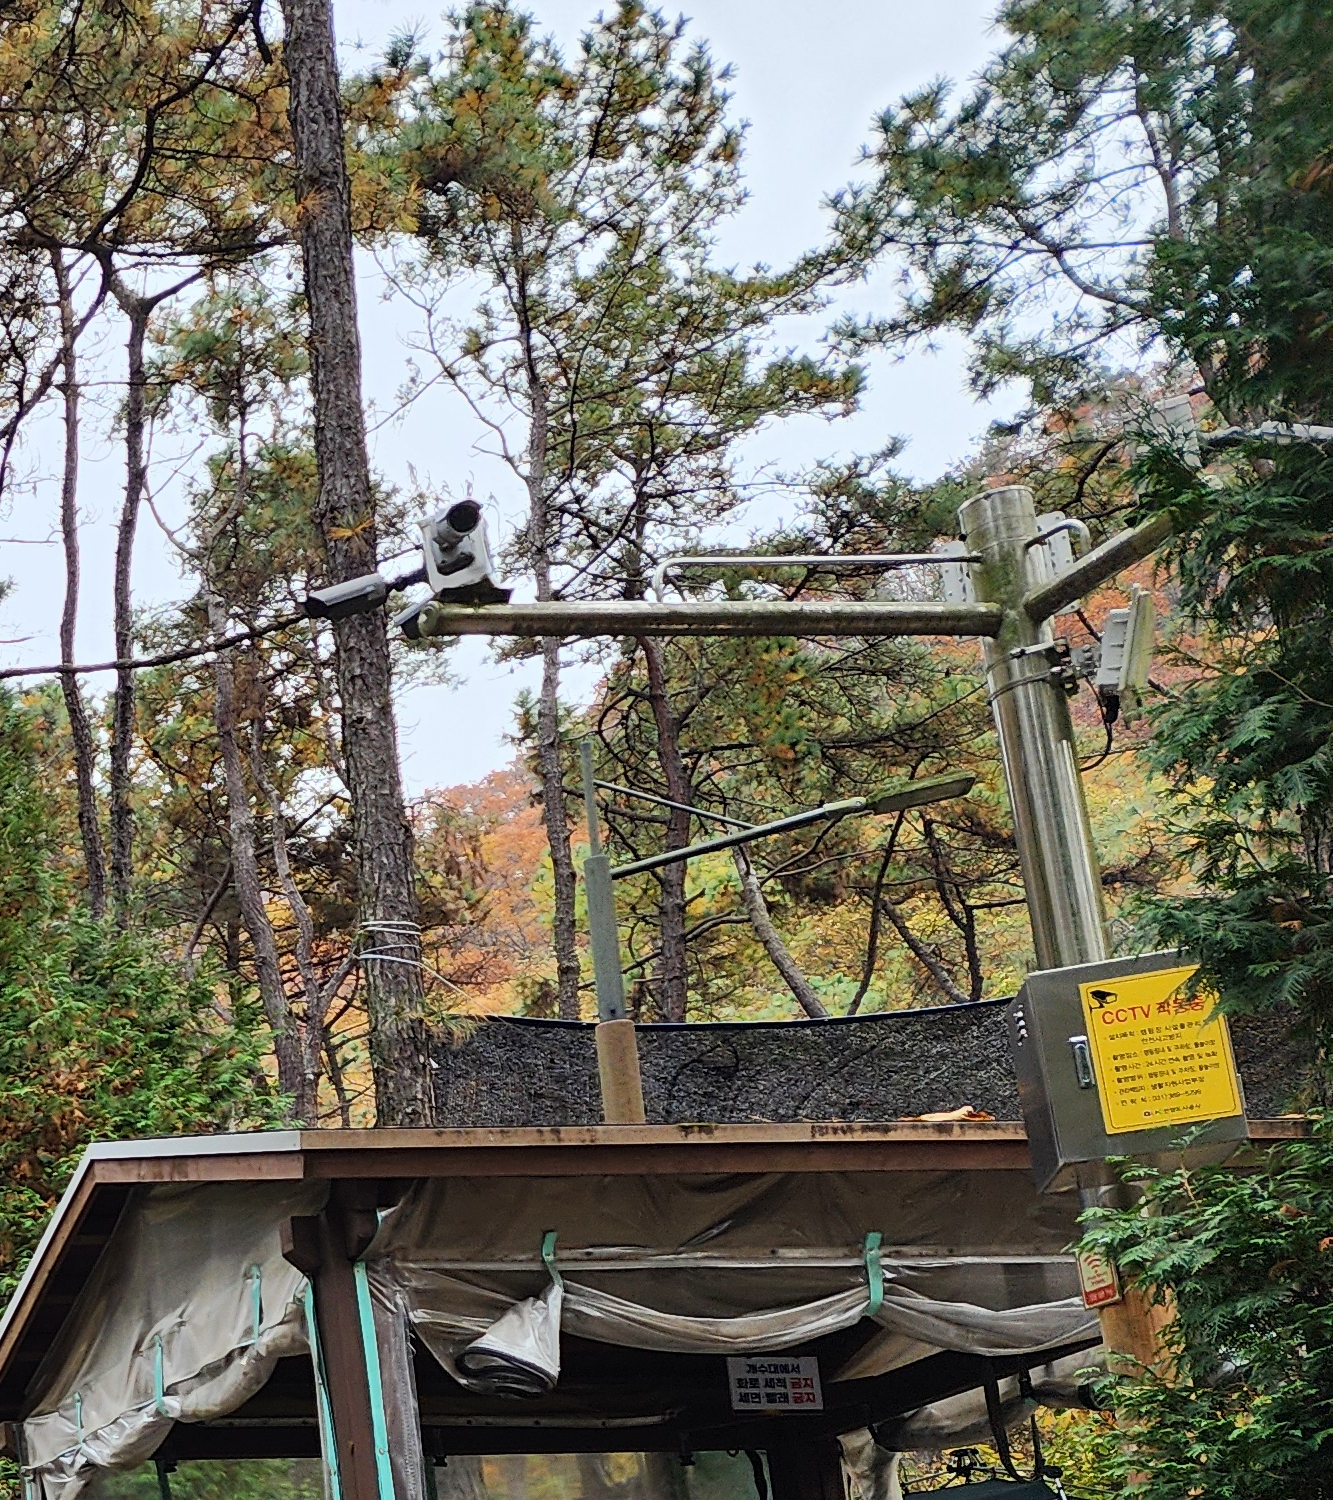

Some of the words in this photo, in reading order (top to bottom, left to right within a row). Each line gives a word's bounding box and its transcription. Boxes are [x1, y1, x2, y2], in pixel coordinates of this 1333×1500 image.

[1101, 1003, 1152, 1025] CCTV
[746, 1363, 802, 1375] 개수대에서
[735, 1377, 761, 1389] 화로
[763, 1377, 788, 1389] 세척
[789, 1377, 815, 1389] 금지
[792, 1392, 817, 1404] 금지
